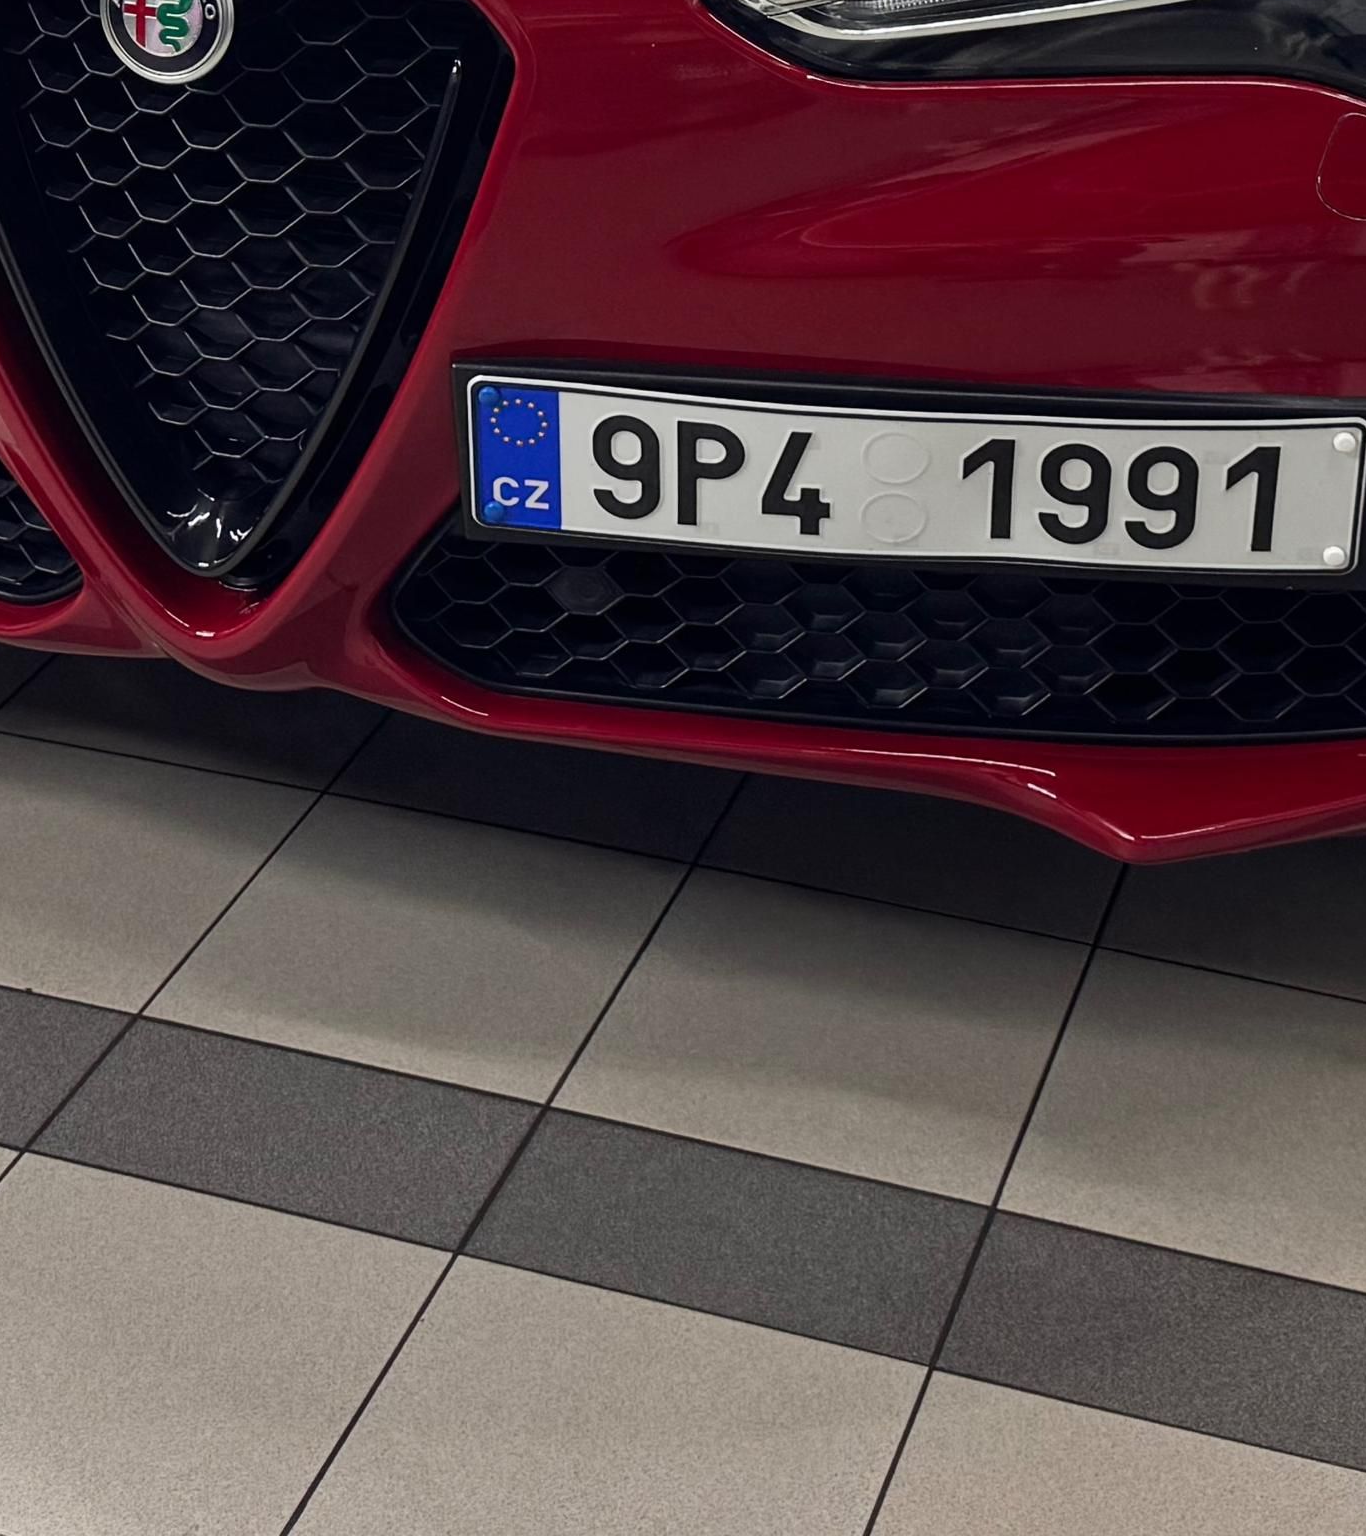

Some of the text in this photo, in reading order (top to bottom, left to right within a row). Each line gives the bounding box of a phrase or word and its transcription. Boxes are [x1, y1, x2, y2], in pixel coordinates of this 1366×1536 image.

[492, 476, 549, 510] CZ
[592, 414, 1281, 552] 9P4 1991
